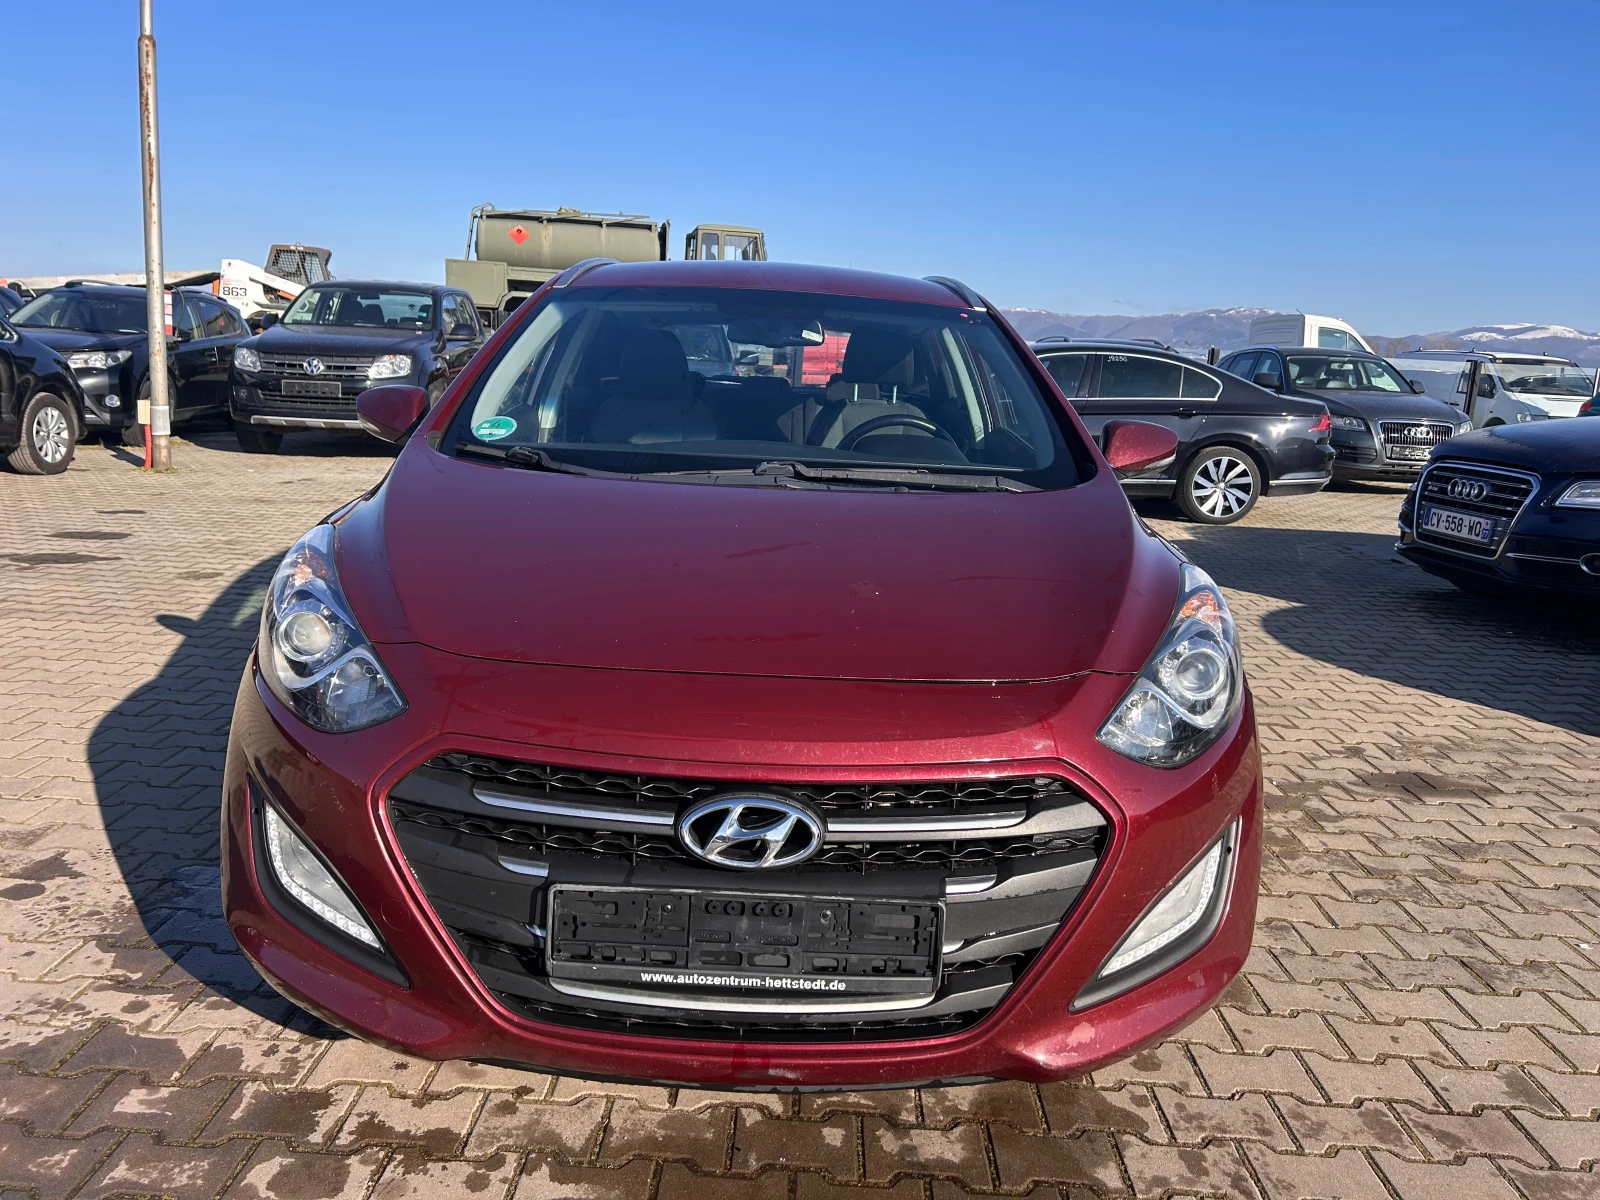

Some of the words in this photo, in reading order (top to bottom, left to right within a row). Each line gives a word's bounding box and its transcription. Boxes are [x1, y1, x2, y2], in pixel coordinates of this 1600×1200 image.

[222, 286, 247, 297] 863
[1430, 512, 1482, 537] CV-558-WQ
[640, 972, 847, 992] www.autozentrum-hettstedt.de
